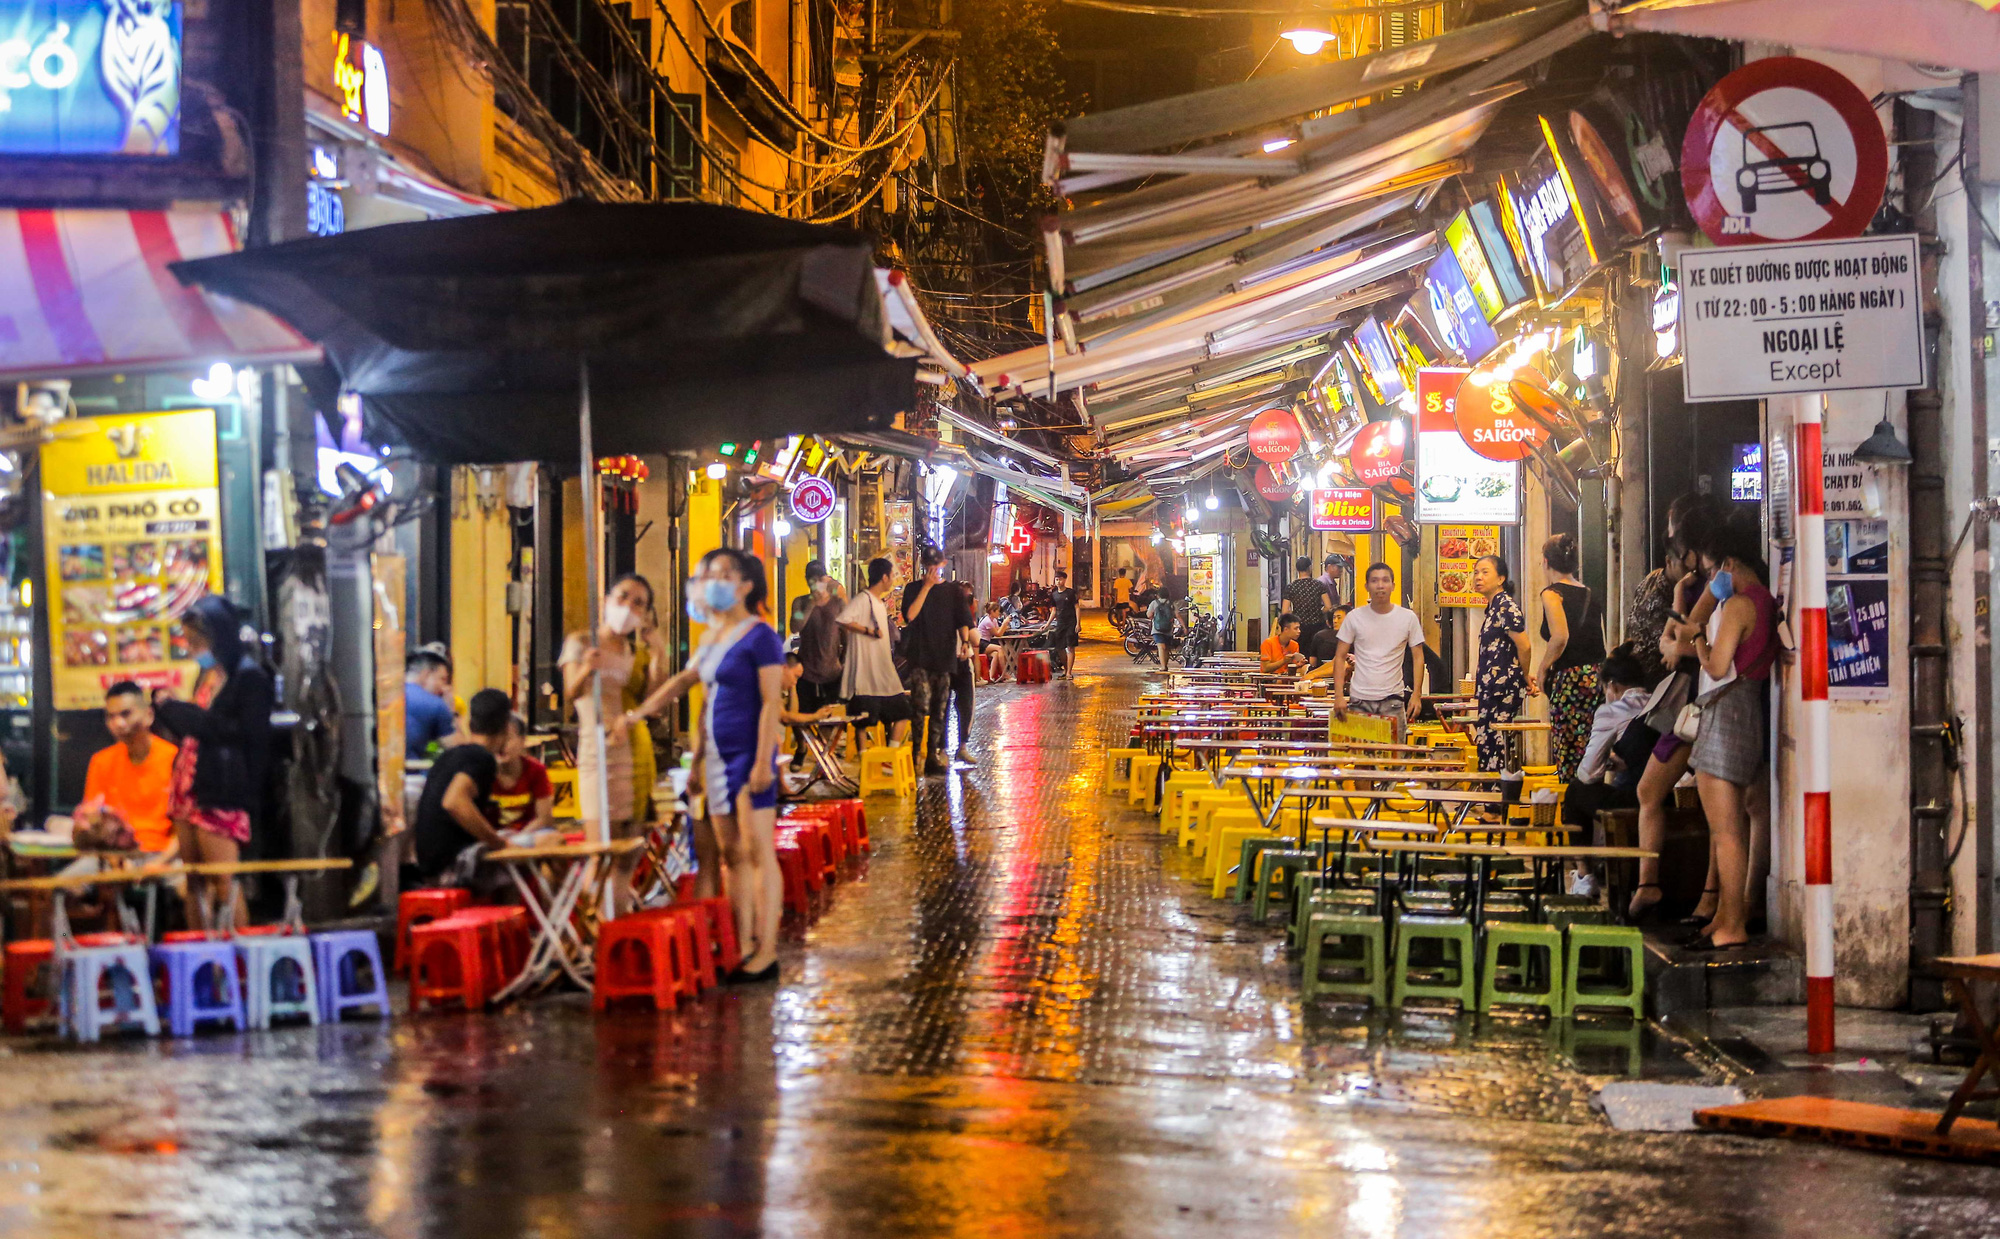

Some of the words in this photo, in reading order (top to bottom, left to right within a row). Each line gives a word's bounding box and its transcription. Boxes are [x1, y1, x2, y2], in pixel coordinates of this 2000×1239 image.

[1690, 269, 1706, 287] XE
[1711, 262, 1742, 285] QUÉT
[1746, 259, 1790, 283] ĐƯỜNG
[1794, 260, 1830, 284] ĐƯỢC
[1834, 257, 1868, 281] HOẠT
[1871, 252, 1908, 280] ĐỘNG
[1819, 285, 1855, 311] HÀNG
[1763, 329, 1818, 355] NGOẠI
[1824, 321, 1844, 353] LỆ
[1770, 358, 1842, 383] Except
[1495, 419, 1514, 428] BIA
[1473, 428, 1536, 442] SAIGON
[1257, 445, 1291, 453] SAIGON
[1364, 465, 1400, 479] SAIGO
[1377, 460, 1391, 468] BIA
[86, 462, 172, 485] HALIDA
[1262, 486, 1290, 494] SAIGON
[1824, 475, 1849, 493] CHẠY
[1320, 501, 1371, 517] Olive
[1316, 518, 1342, 526] Snacks
[1342, 518, 1347, 526] &
[1348, 518, 1370, 526] Drinks
[1856, 600, 1886, 622] 25.000
[1849, 655, 1881, 678] NGHIỆM
